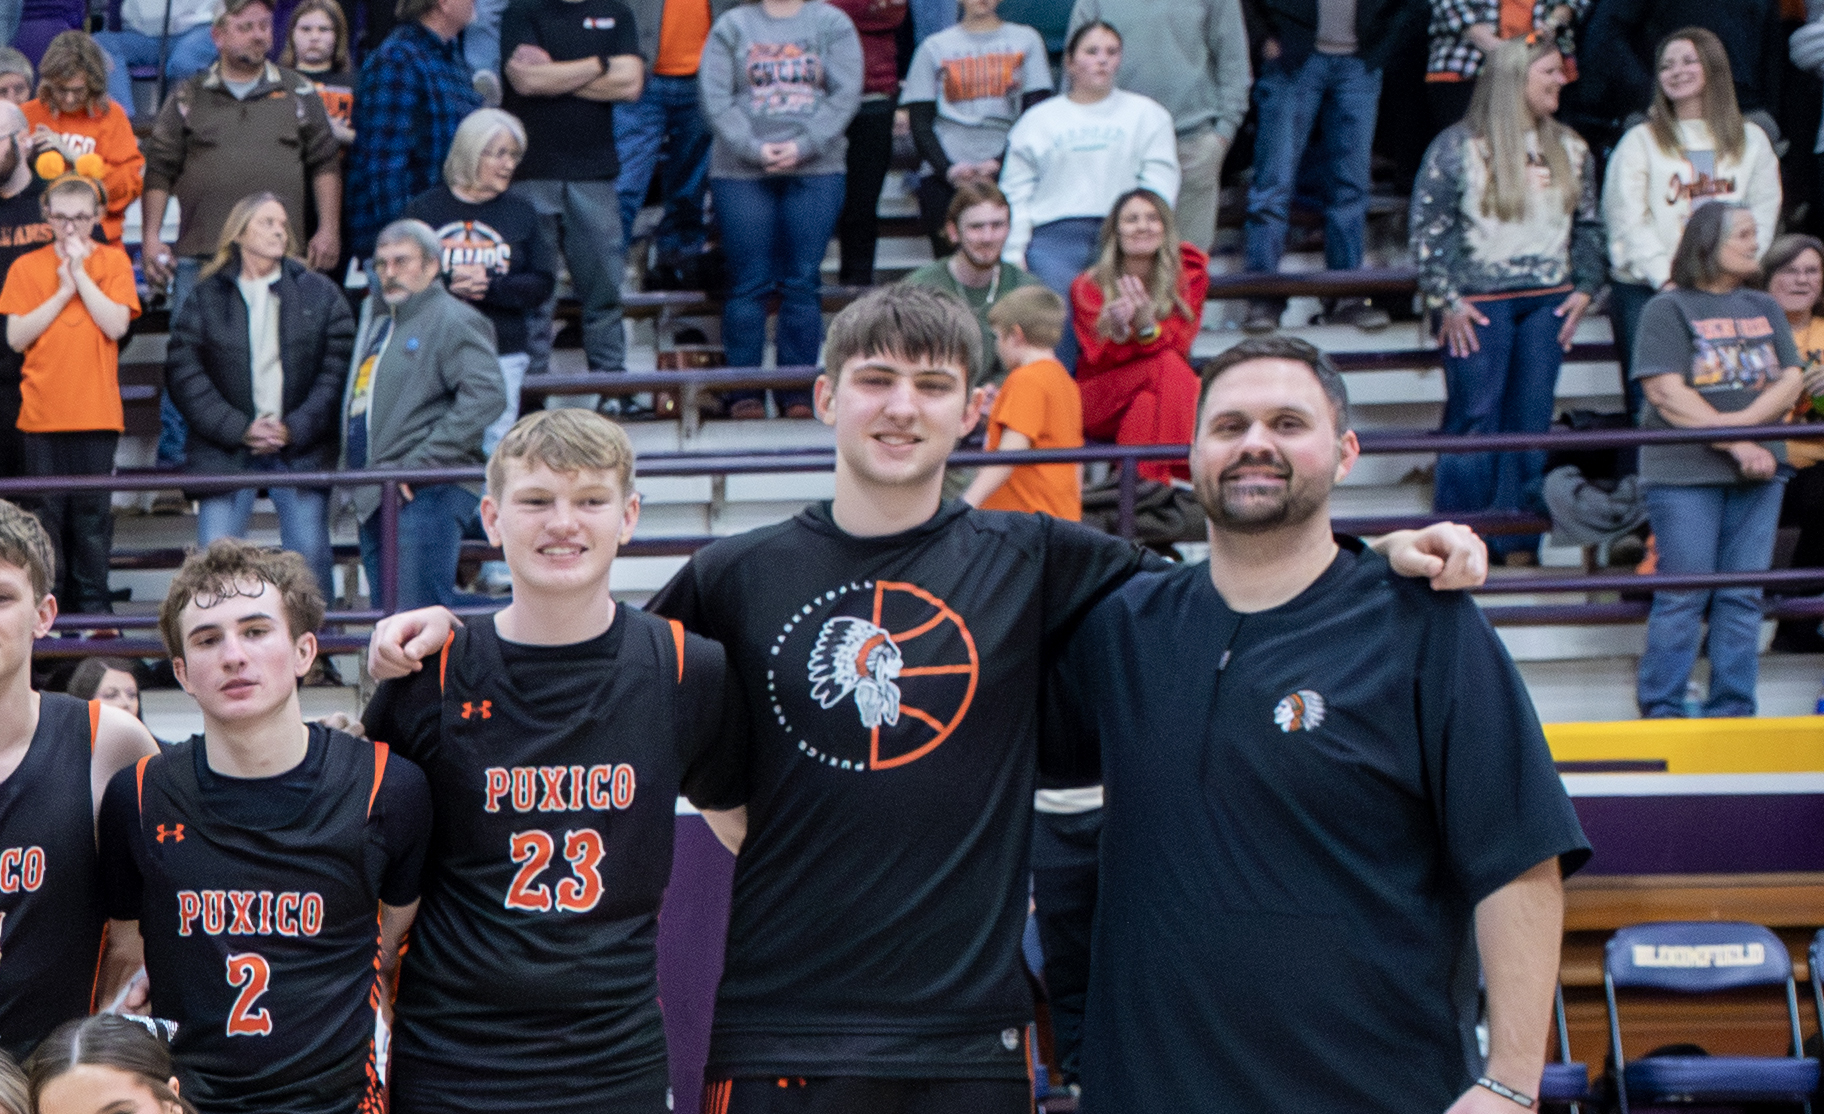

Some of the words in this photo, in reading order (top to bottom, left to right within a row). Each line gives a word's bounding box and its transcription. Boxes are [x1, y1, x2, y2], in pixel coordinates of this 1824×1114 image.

[485, 763, 636, 812] PUXICO
[504, 828, 605, 912] 23
[177, 890, 324, 937] PUXICO
[225, 953, 273, 1036] 2
